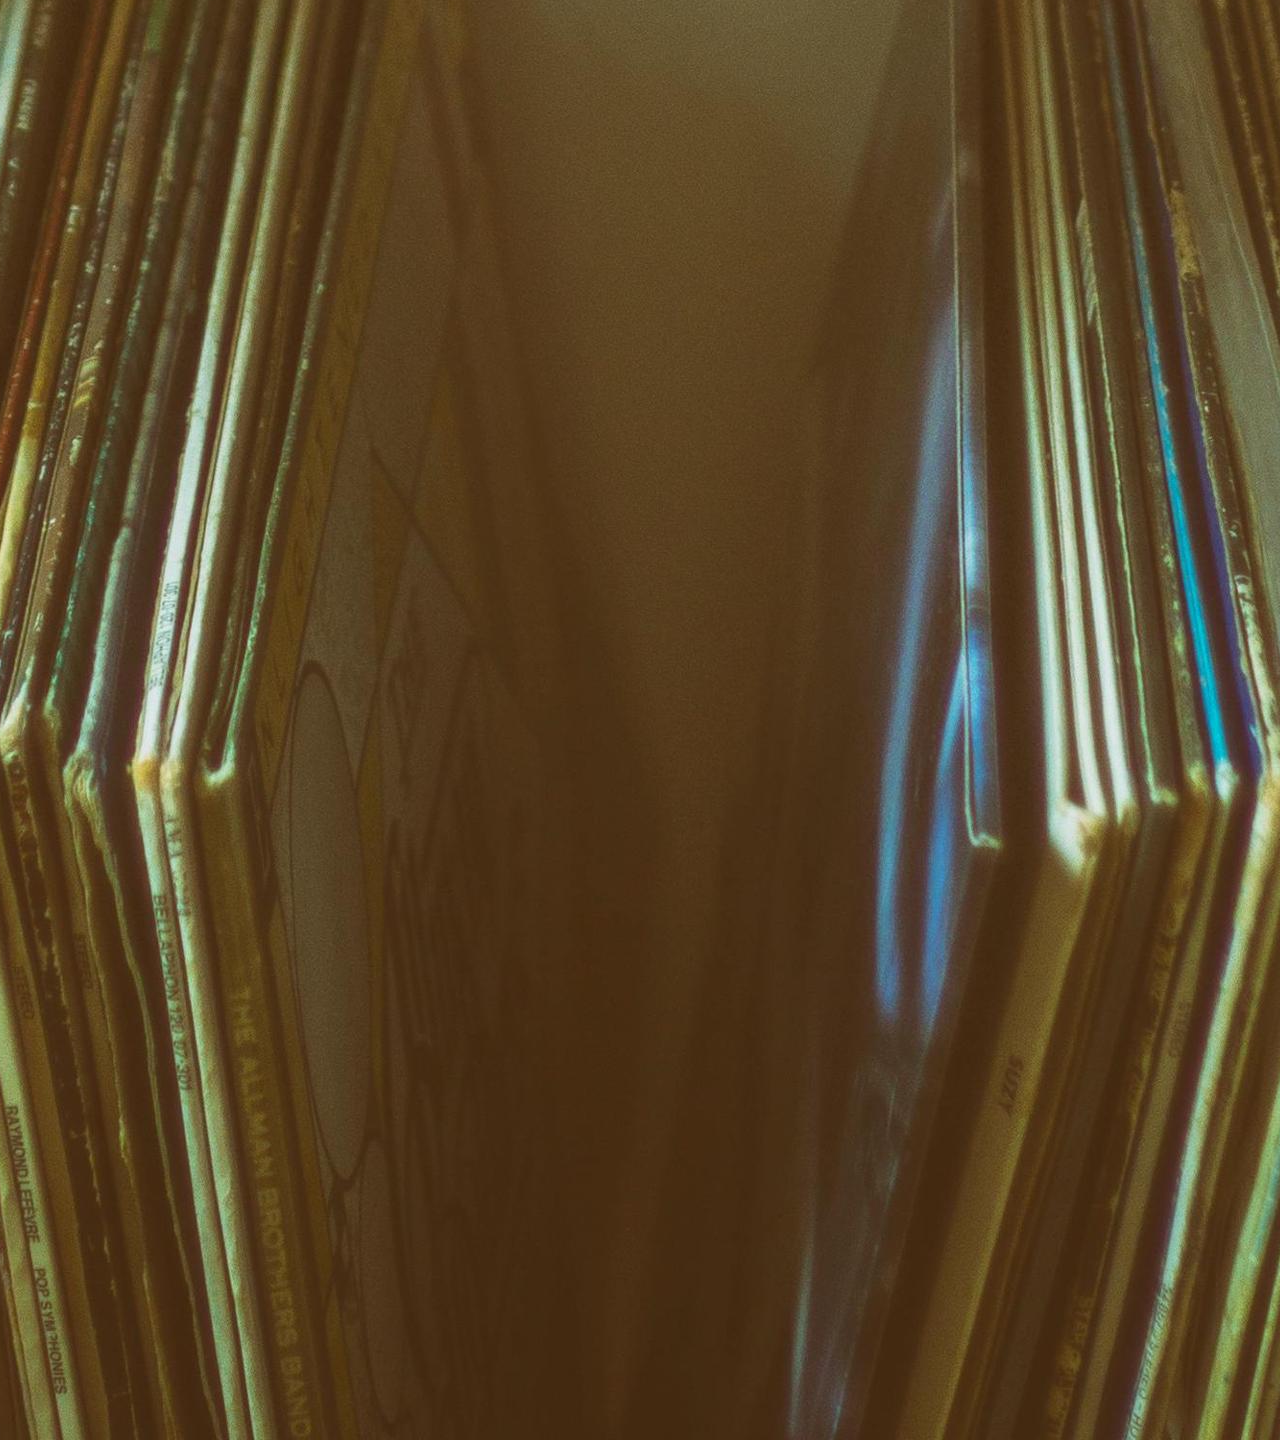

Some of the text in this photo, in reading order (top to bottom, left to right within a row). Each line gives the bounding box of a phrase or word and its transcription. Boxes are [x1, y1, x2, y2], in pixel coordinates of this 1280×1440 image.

[998, 1054, 1024, 1118] SUZY
[4, 1104, 26, 1179] RAYMOND
[231, 987, 313, 1438] THE ALLMAN BROTHERS BAND
[34, 1266, 50, 1299] POP
